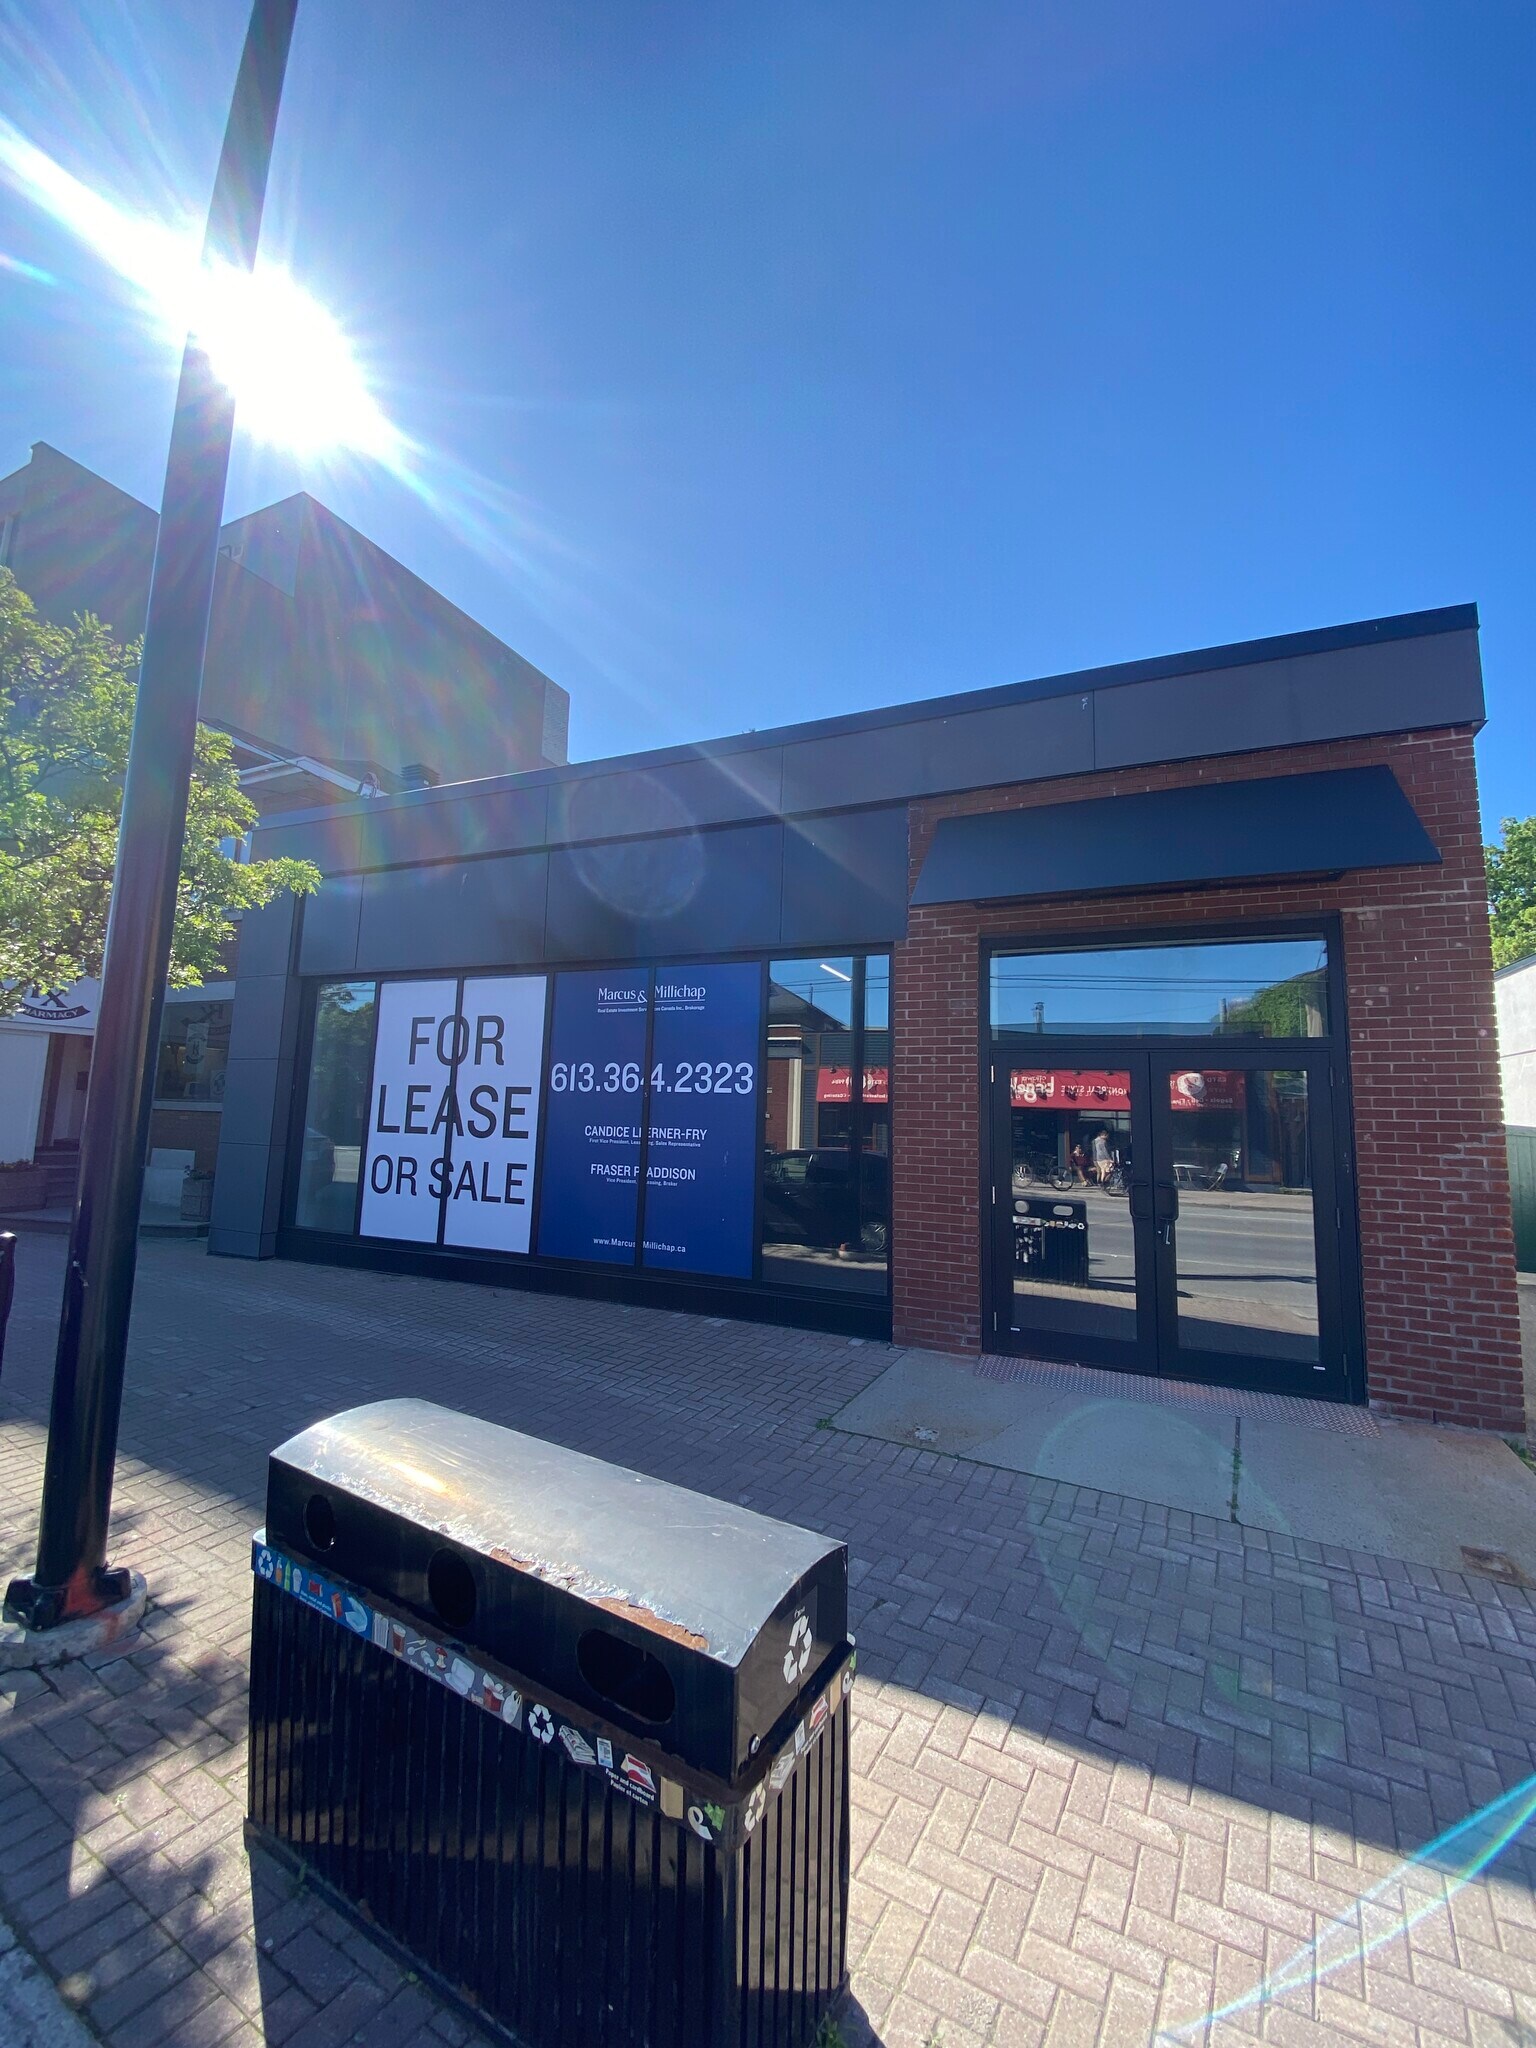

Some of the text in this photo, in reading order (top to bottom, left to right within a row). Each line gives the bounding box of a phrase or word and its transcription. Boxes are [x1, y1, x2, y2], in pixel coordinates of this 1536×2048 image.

[598, 984, 706, 1003] Marcus & Millichap
[23, 1004, 78, 1018] HARMACY
[408, 1014, 505, 1066] FOR
[551, 1062, 754, 1095] 613.364.2323
[376, 1084, 532, 1139] LEASE
[584, 1125, 630, 1138] CANDICE
[371, 1154, 528, 1205] OR SALE
[590, 1163, 696, 1181] FRASER PADDISON
[593, 1238, 686, 1253] www.MarcusMillichap.ca
